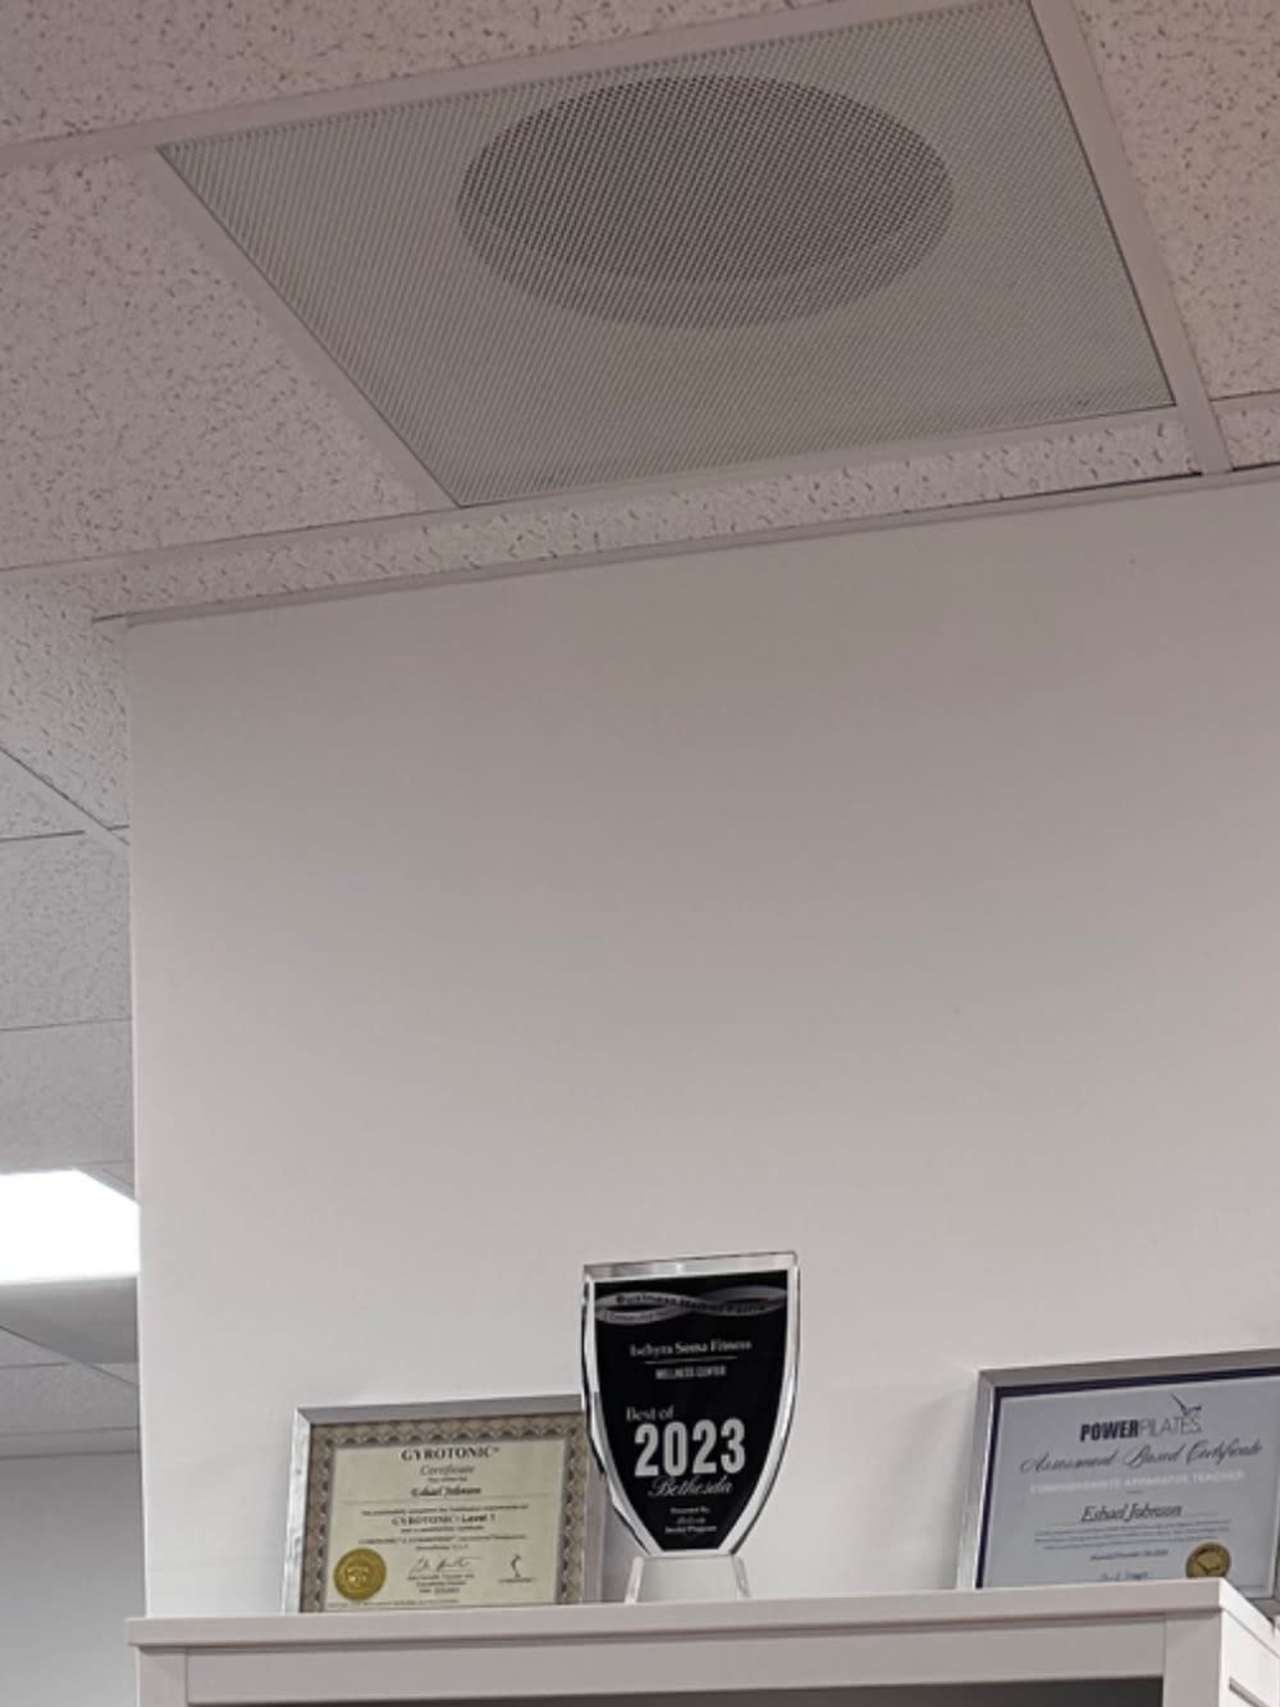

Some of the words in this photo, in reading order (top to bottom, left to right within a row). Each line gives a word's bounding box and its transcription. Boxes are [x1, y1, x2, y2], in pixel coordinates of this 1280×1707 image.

[626, 1406, 656, 1422] Best
[658, 1404, 675, 1420] of
[634, 1417, 746, 1478] 2023
[1186, 1437, 1263, 1464] Certificate
[648, 1474, 733, 1497] Bethesda
